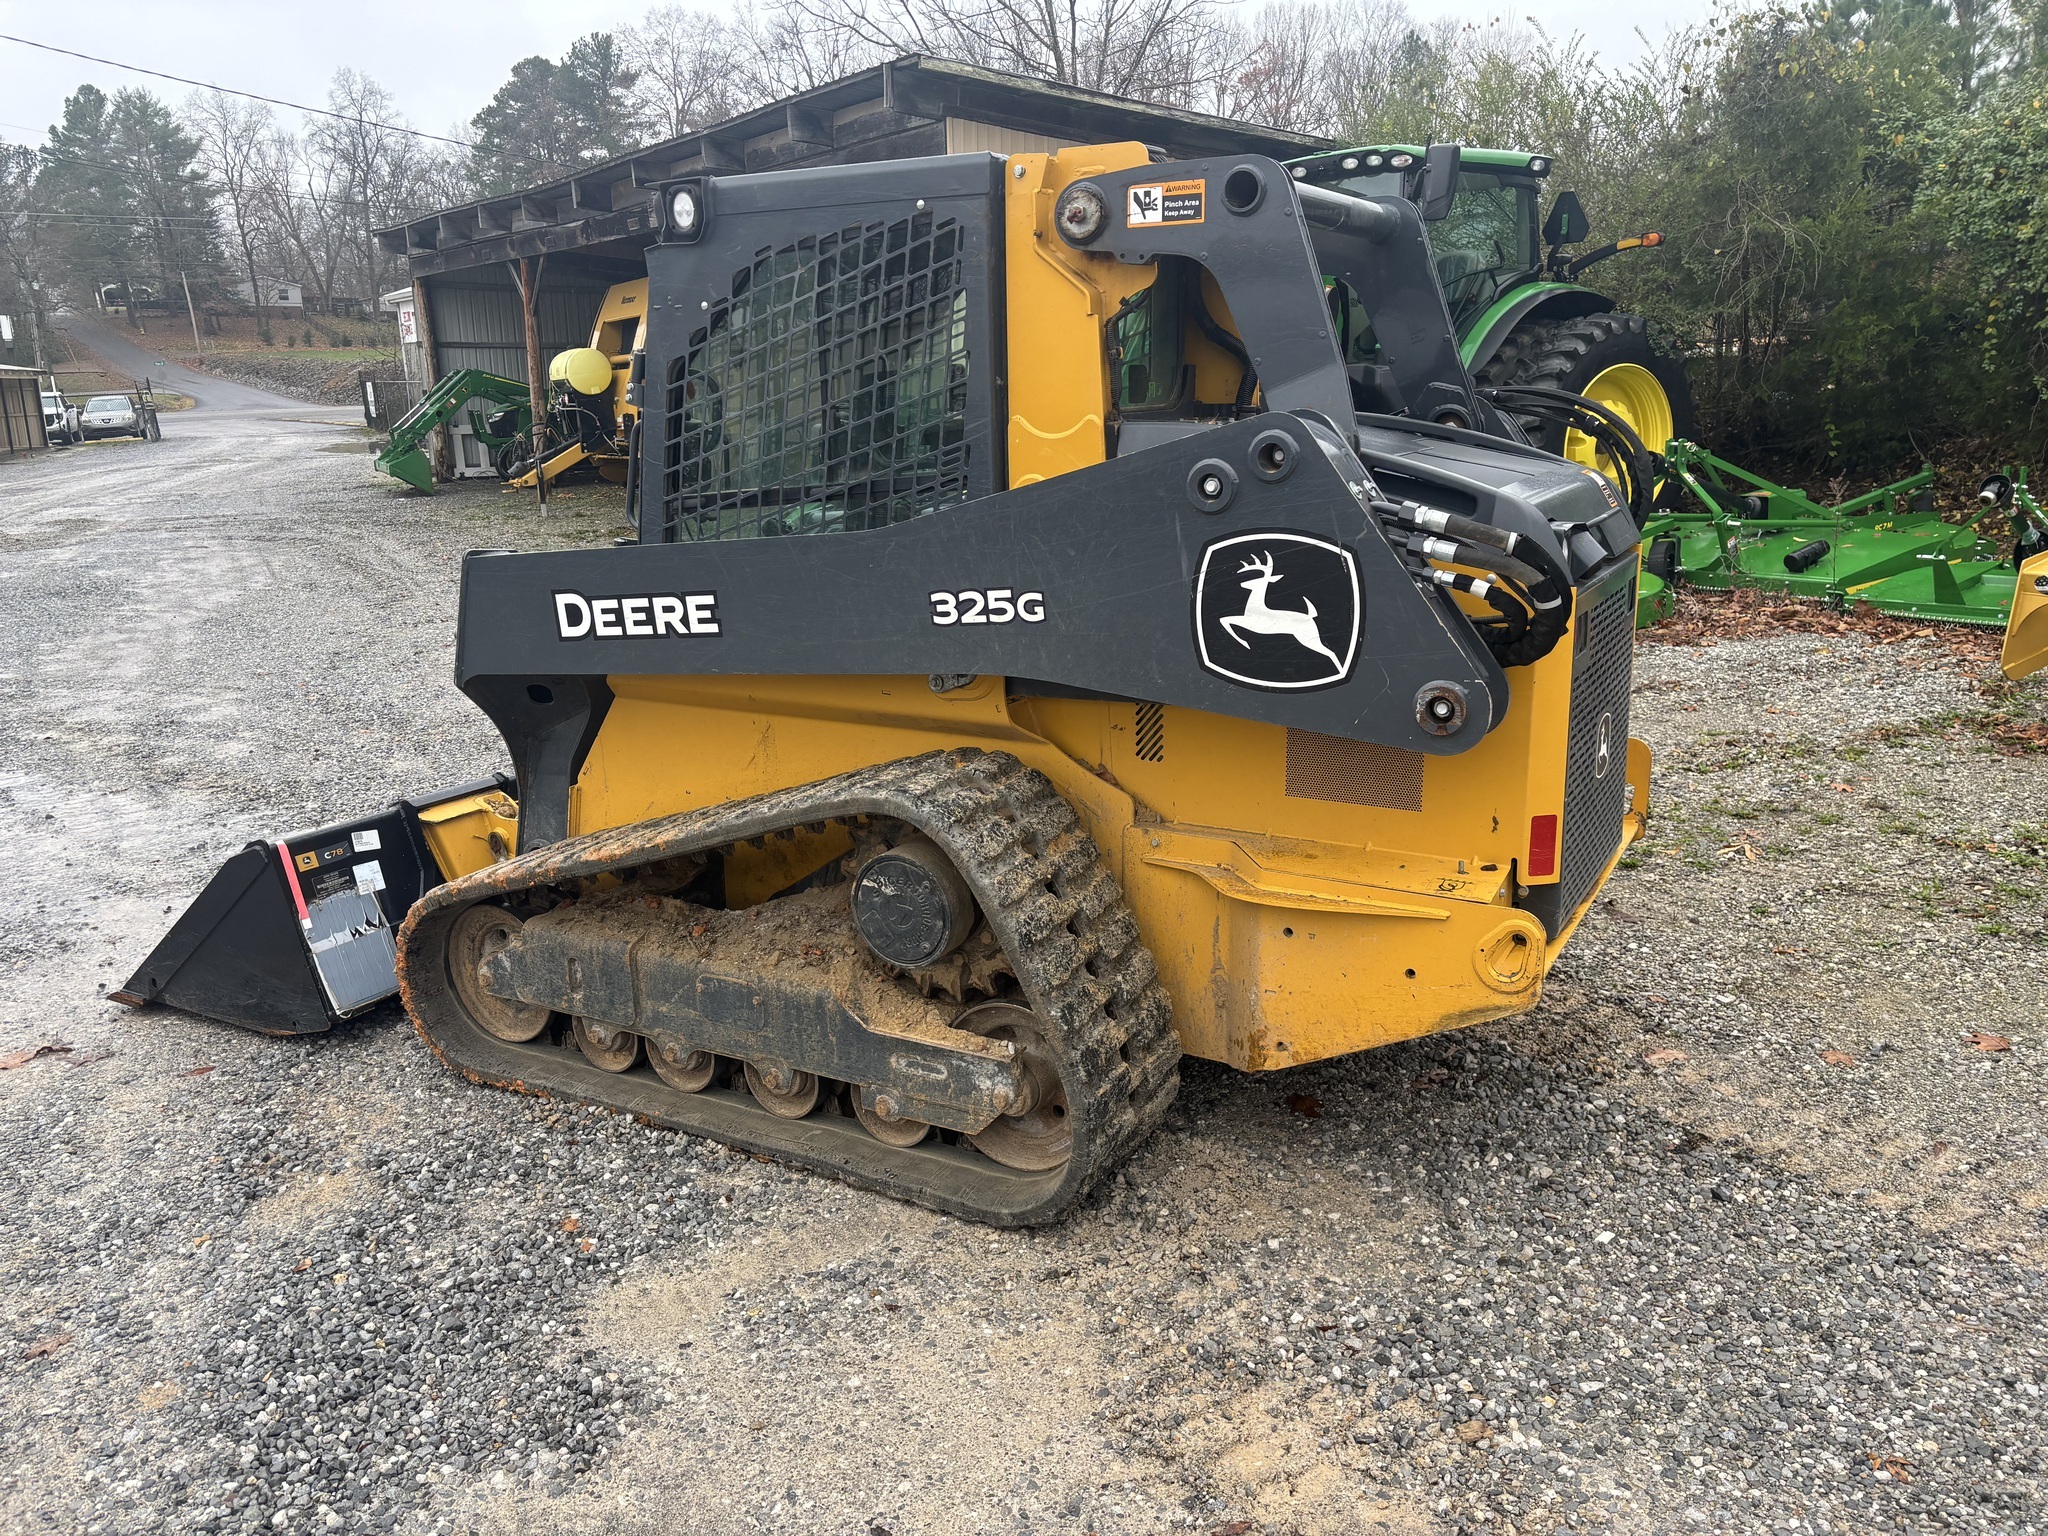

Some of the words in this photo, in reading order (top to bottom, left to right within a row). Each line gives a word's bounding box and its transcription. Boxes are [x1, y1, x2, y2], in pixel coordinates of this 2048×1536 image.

[1172, 184, 1201, 192] WARNING
[1164, 200, 1183, 208] Pinch
[1185, 199, 1200, 207] Area
[1179, 208, 1195, 216] Away
[930, 589, 1045, 625] 325G
[554, 593, 719, 637] DEERE
[324, 848, 344, 859] C78
